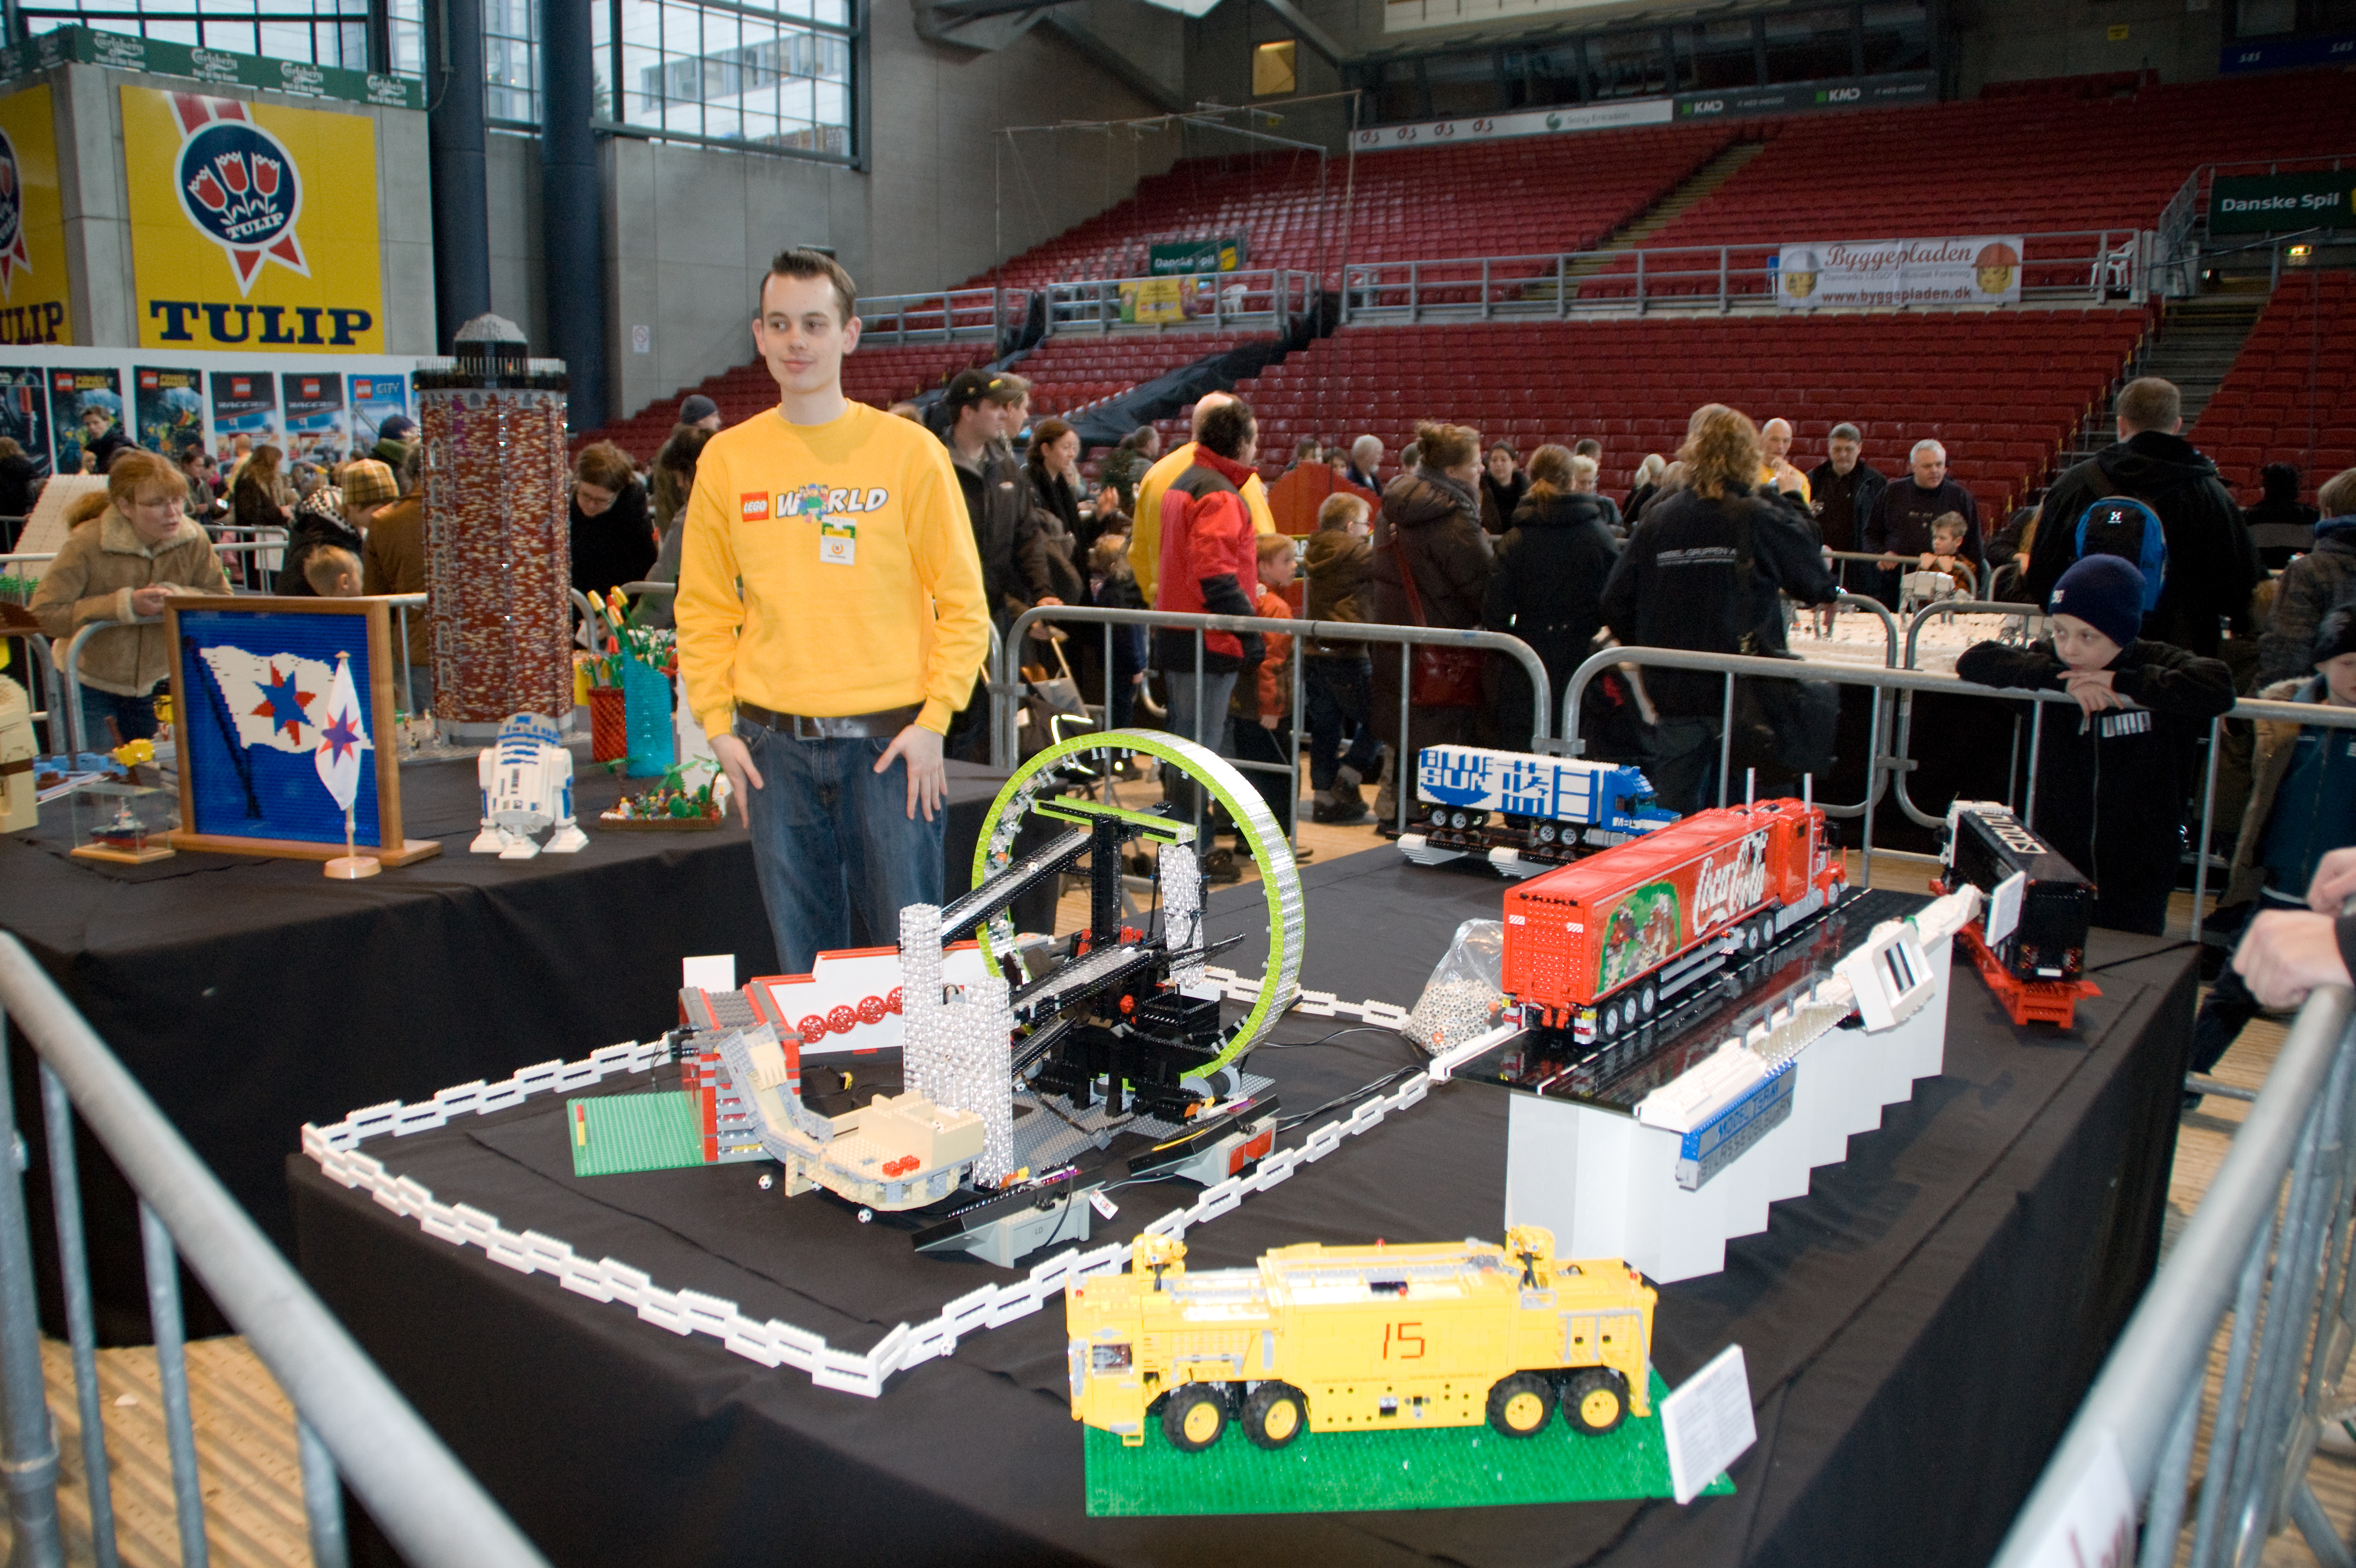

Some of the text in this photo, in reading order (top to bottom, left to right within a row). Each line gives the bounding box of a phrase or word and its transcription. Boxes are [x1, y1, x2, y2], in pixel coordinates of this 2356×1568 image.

[191, 47, 237, 69] Carlsberg
[281, 61, 324, 82] Carlsberg
[367, 74, 407, 96] Carlsberg
[1829, 88, 1861, 102] KMD
[1694, 100, 1724, 112] KMD
[2221, 192, 2340, 212] Danske Spil
[226, 211, 285, 240] TULIP
[1824, 241, 1972, 272] Byggepladen
[1822, 286, 1972, 304] www.byggepladen.dk
[0, 301, 63, 345] ULIP
[149, 300, 373, 346] TULIP
[375, 382, 400, 395] CITY
[742, 487, 889, 519] LEGO WRLD
[1035, 1227, 1043, 1235] LD
[1383, 1322, 1425, 1360] 15
